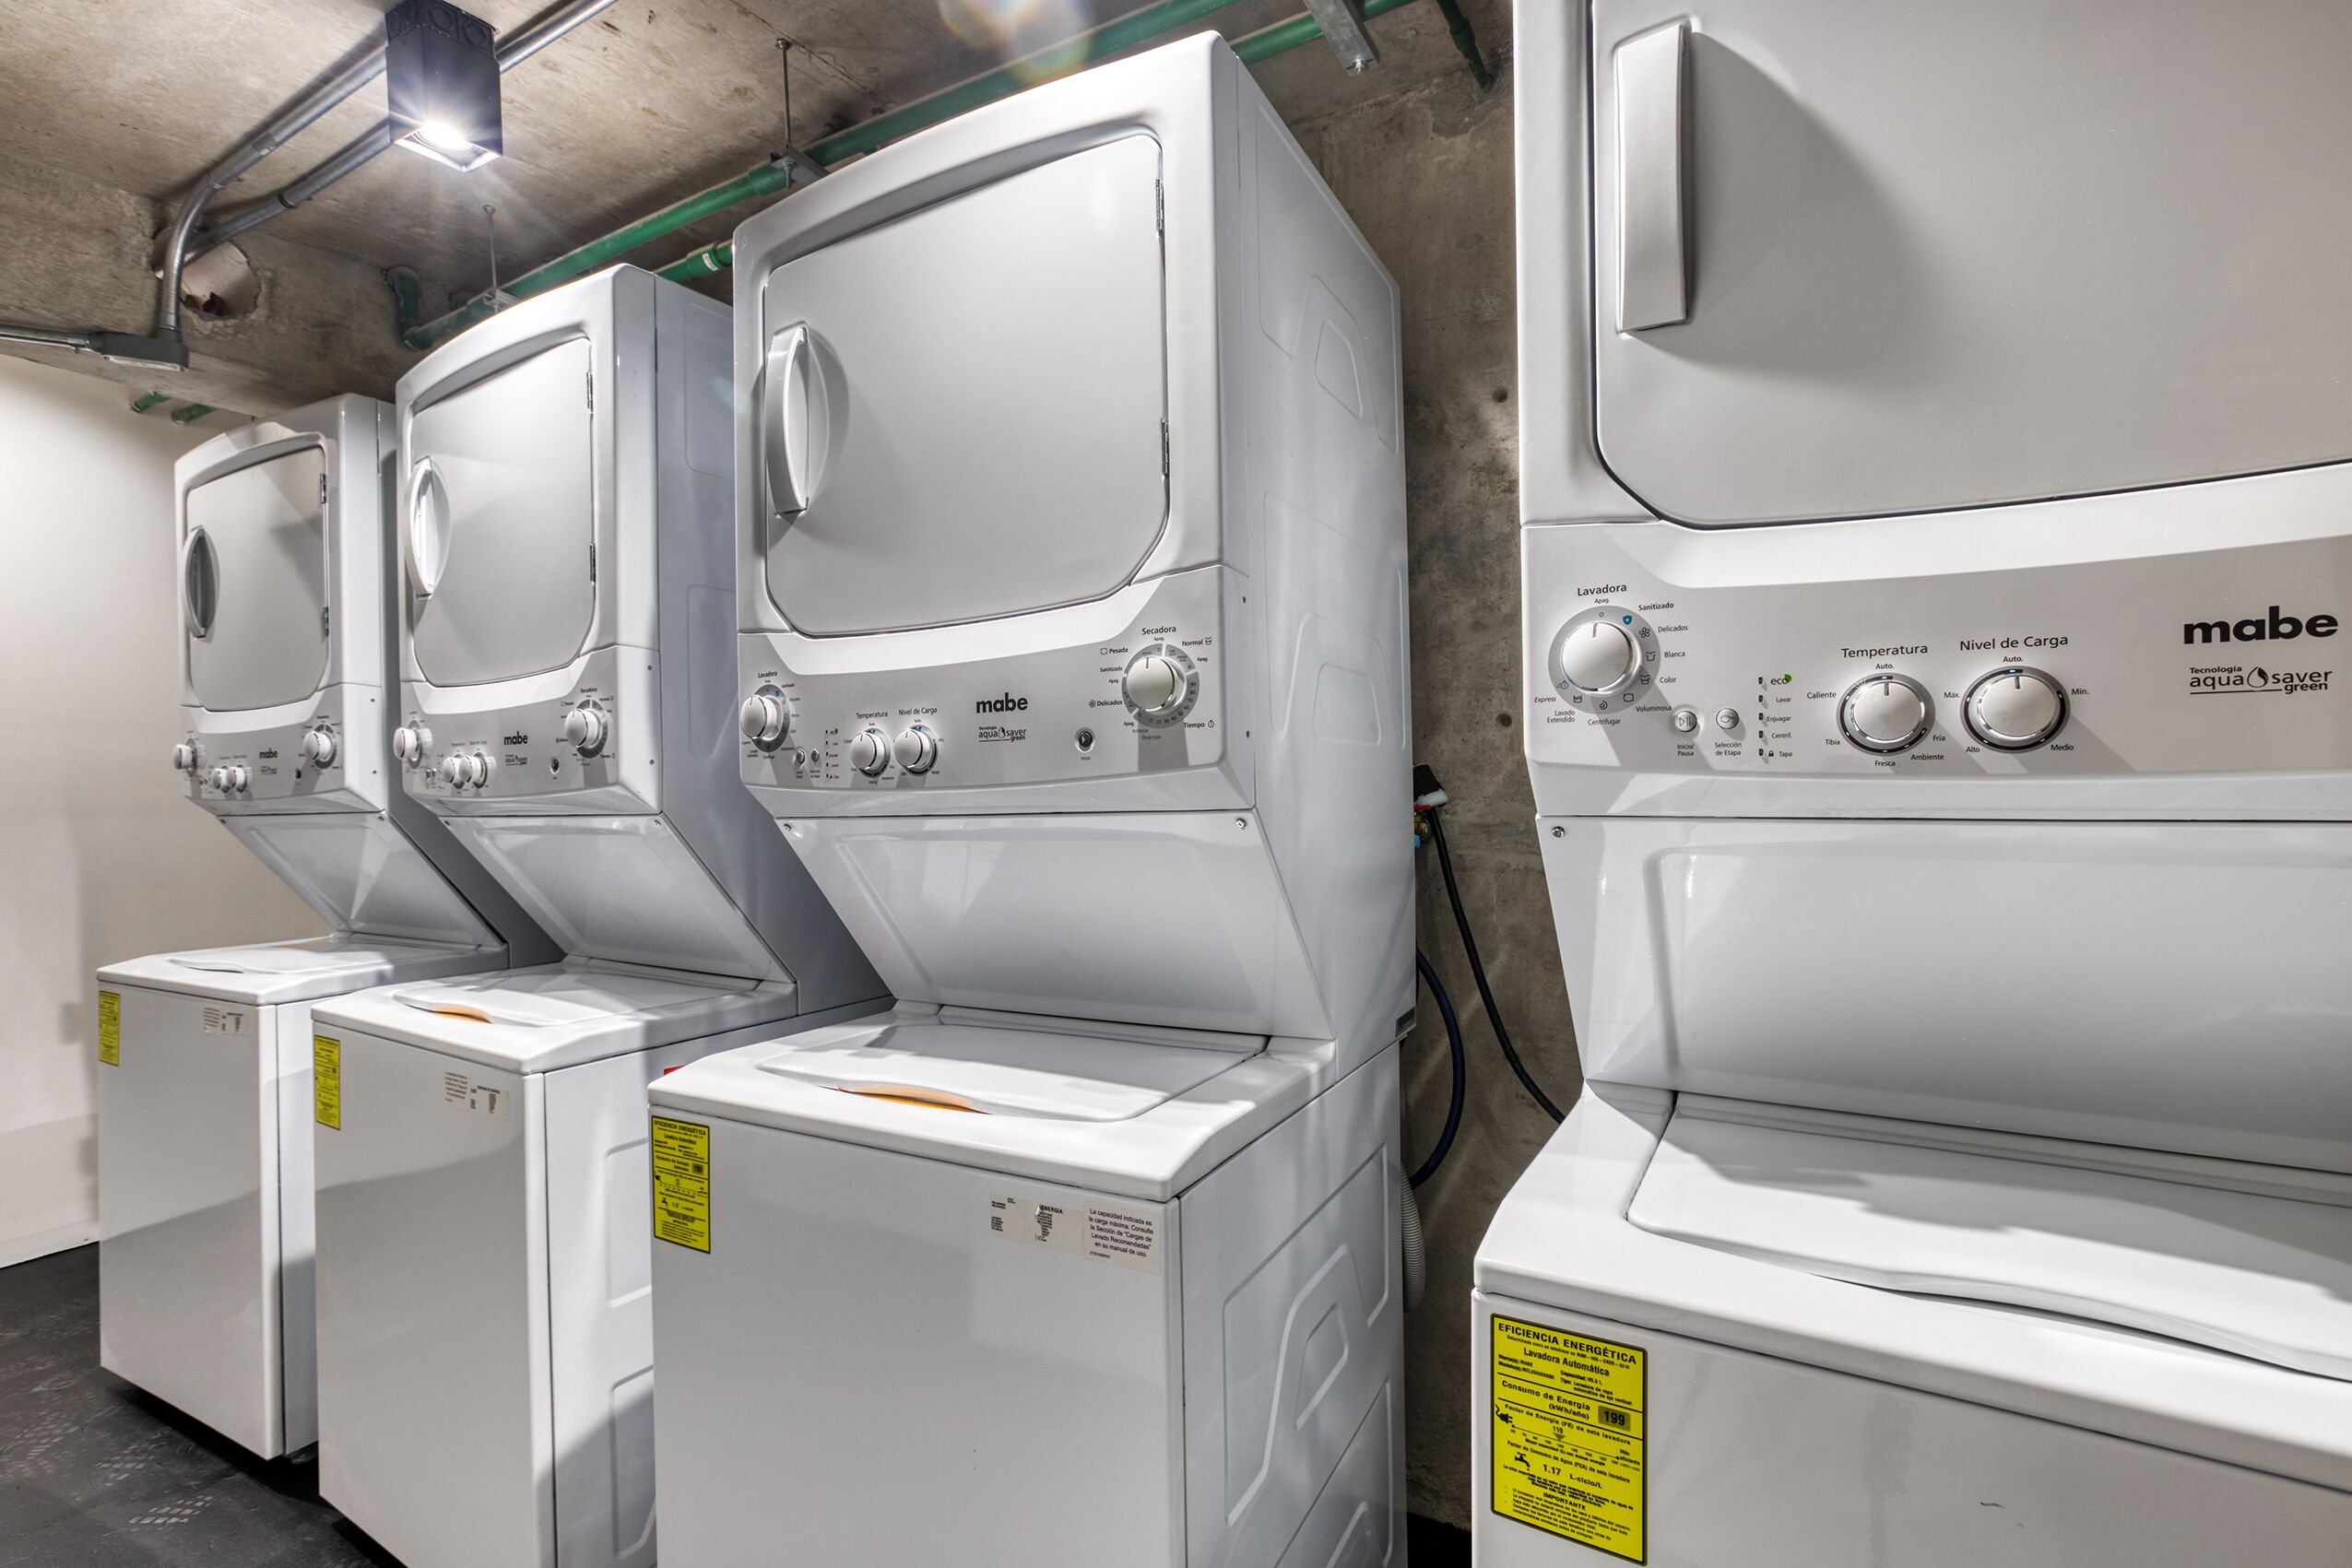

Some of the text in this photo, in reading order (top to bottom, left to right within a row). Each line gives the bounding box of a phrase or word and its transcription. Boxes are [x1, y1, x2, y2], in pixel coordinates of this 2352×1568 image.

[1578, 583, 1627, 596] Lavadora
[1638, 602, 1674, 611] Sanitizado
[1141, 626, 1176, 635] Secadora
[1658, 624, 1688, 632] Delicados
[2183, 606, 2338, 644] mabe
[1960, 636, 2068, 651] Nivel de Carga
[1663, 650, 1685, 658] Blanca
[1841, 645, 1928, 659] Temperatura
[757, 670, 778, 678] Lavadora
[2189, 670, 2333, 690] aqua saver
[2284, 681, 2328, 694] green
[976, 691, 1028, 713] mabe
[1807, 691, 1837, 700] Caliente
[504, 730, 528, 745] mabe
[978, 728, 1027, 739] aqua saver
[1094, 1218, 1108, 1226] carga
[1097, 1210, 1122, 1220] capacidad
[1124, 1215, 1144, 1224] indicada
[1091, 1232, 1109, 1241] Lavado
[1109, 1244, 1128, 1253] manual
[1498, 1322, 1637, 1364] EFICIENCIA ENERGÉTICA
[1523, 1347, 1560, 1363] Lavadora
[1563, 1357, 1610, 1376] Automática
[1502, 1379, 1541, 1397] Consumo
[1542, 1392, 1554, 1401] de
[1505, 1403, 1524, 1414] Factor
[1525, 1409, 1533, 1417] de
[1586, 1428, 1601, 1437] esta
[1601, 1431, 1631, 1445] lavadora
[1603, 1409, 1625, 1426] 199
[1542, 1464, 1561, 1476] 1.17
[1542, 1491, 1586, 1511] IMPORTANTE
